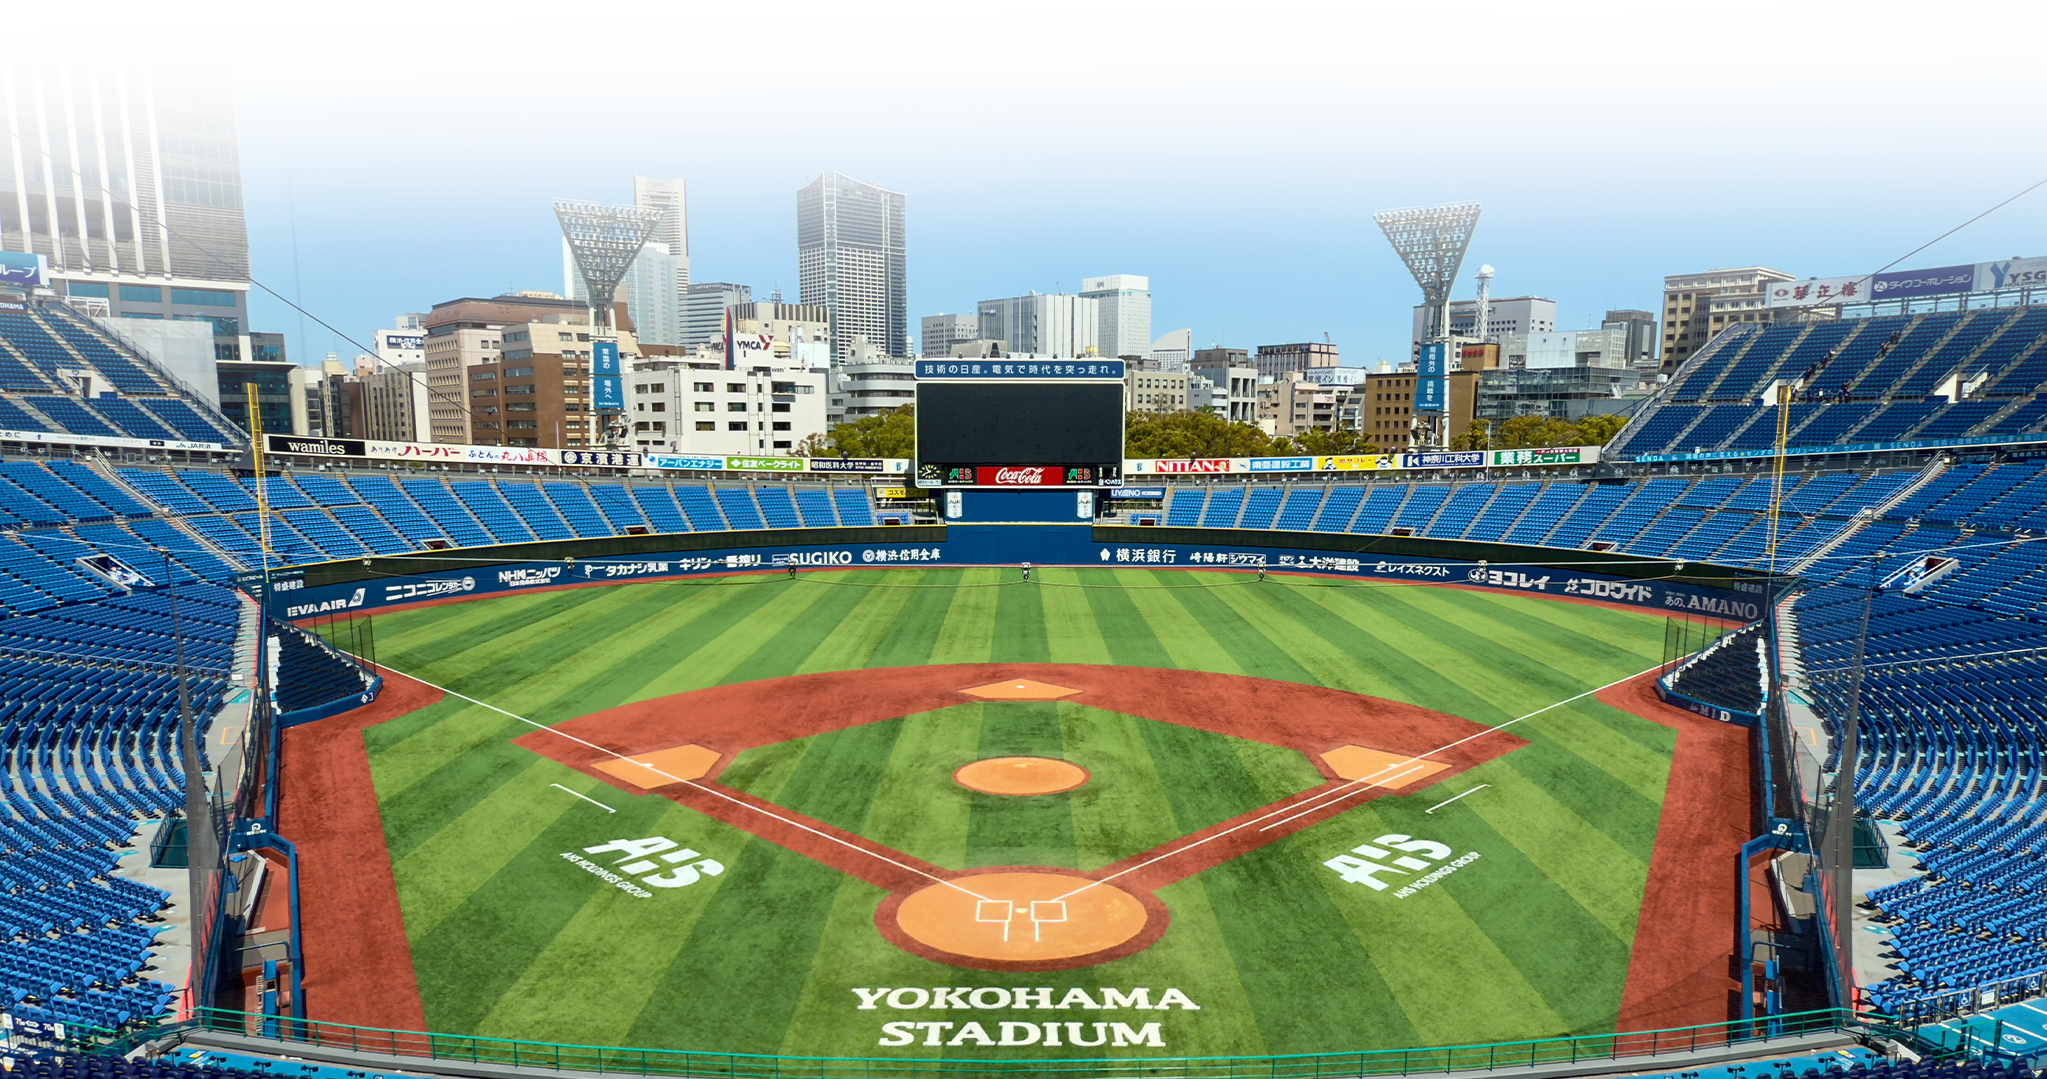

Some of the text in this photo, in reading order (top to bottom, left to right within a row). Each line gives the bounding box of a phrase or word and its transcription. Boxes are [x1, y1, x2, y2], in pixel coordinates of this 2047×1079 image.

[1888, 274, 1972, 290] ダイワコーポレーション
[2004, 279, 2046, 287] HOLDINGS
[2009, 270, 2046, 283] YSG
[737, 340, 761, 350] YMCA
[925, 364, 1117, 375] 技術の日産。電気で時代を突っ走れ。
[287, 440, 346, 455] wamiles
[1889, 440, 1923, 449] SENDA
[659, 458, 723, 468] アーバンエナジー
[742, 457, 801, 469] 住友ベークライト
[811, 460, 854, 470] 昭和医科大学
[1252, 460, 1310, 470] 東亜建設工業
[1421, 453, 1480, 465] 神奈川工科大学
[1500, 450, 1576, 466] 業務スーパー
[1155, 460, 1215, 472] NITTAN
[995, 467, 1045, 484] Coca-Cola
[1111, 489, 1141, 497] UYENO
[789, 551, 852, 565] SUGIKO
[875, 548, 941, 562] 横浜信用金庫
[1116, 548, 1177, 563] 横浜銀行
[1189, 552, 1266, 564] 崎陽軒 シウマイ
[605, 561, 669, 577] タカナシ乳業
[1309, 556, 1360, 572] 大洋建設
[1387, 562, 1451, 577] レイズネクスト
[1488, 569, 1551, 590] ヨコレイ
[1580, 578, 1653, 602] コロワイド
[1686, 595, 1758, 619] AMANO
[560, 852, 652, 898] AHS HOLDINGS GROUP
[1393, 852, 1481, 899] AHS HOLDINGS GROUP
[851, 987, 1201, 1010] YOKOHAMA
[879, 1021, 1166, 1047] STADIUM
